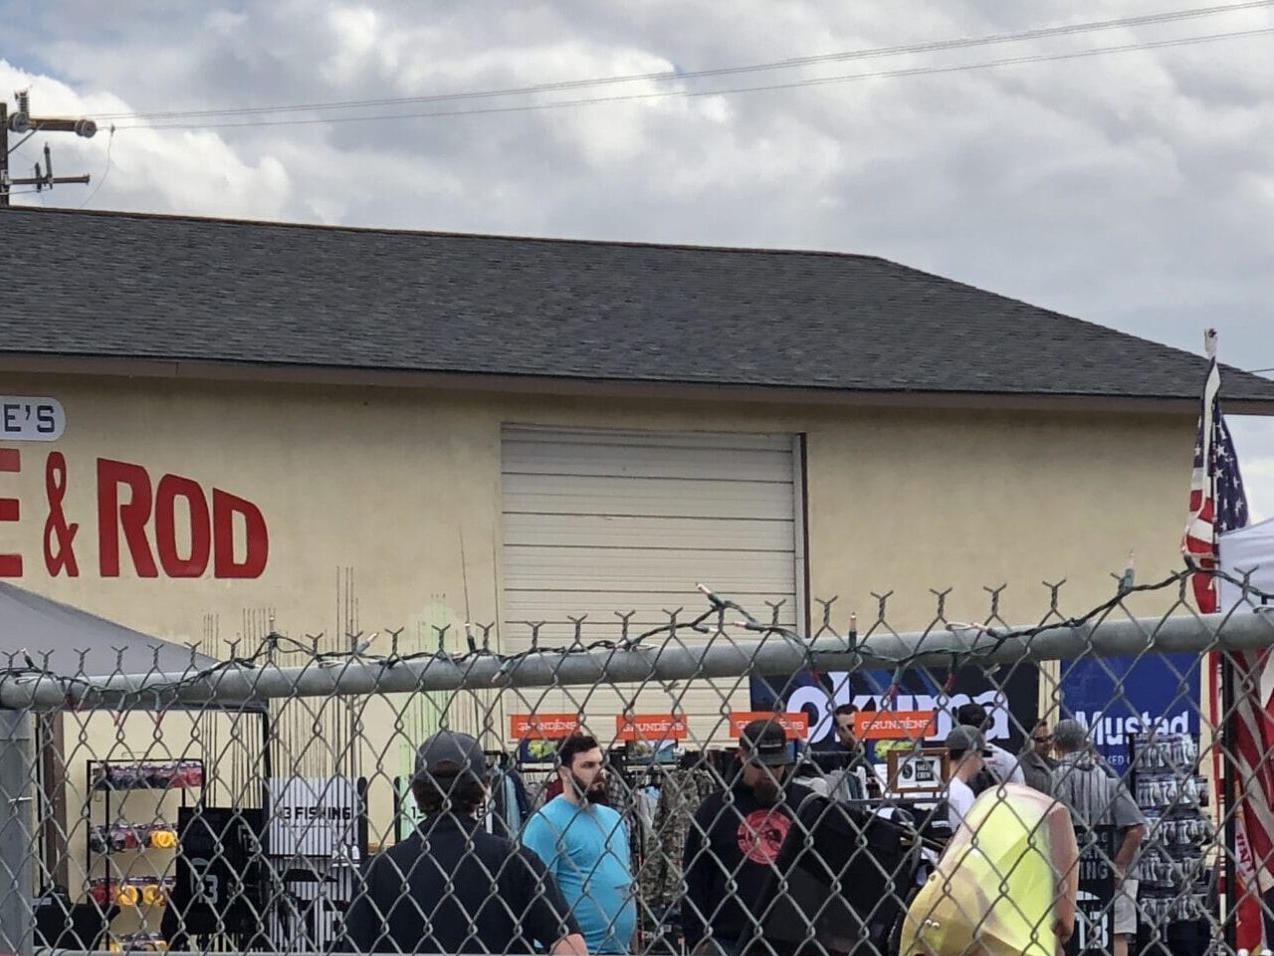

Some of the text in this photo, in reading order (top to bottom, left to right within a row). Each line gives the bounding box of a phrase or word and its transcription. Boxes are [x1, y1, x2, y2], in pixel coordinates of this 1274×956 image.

[43, 451, 79, 577] &
[97, 458, 269, 579] ROD
[1075, 710, 1189, 745] Mustad
